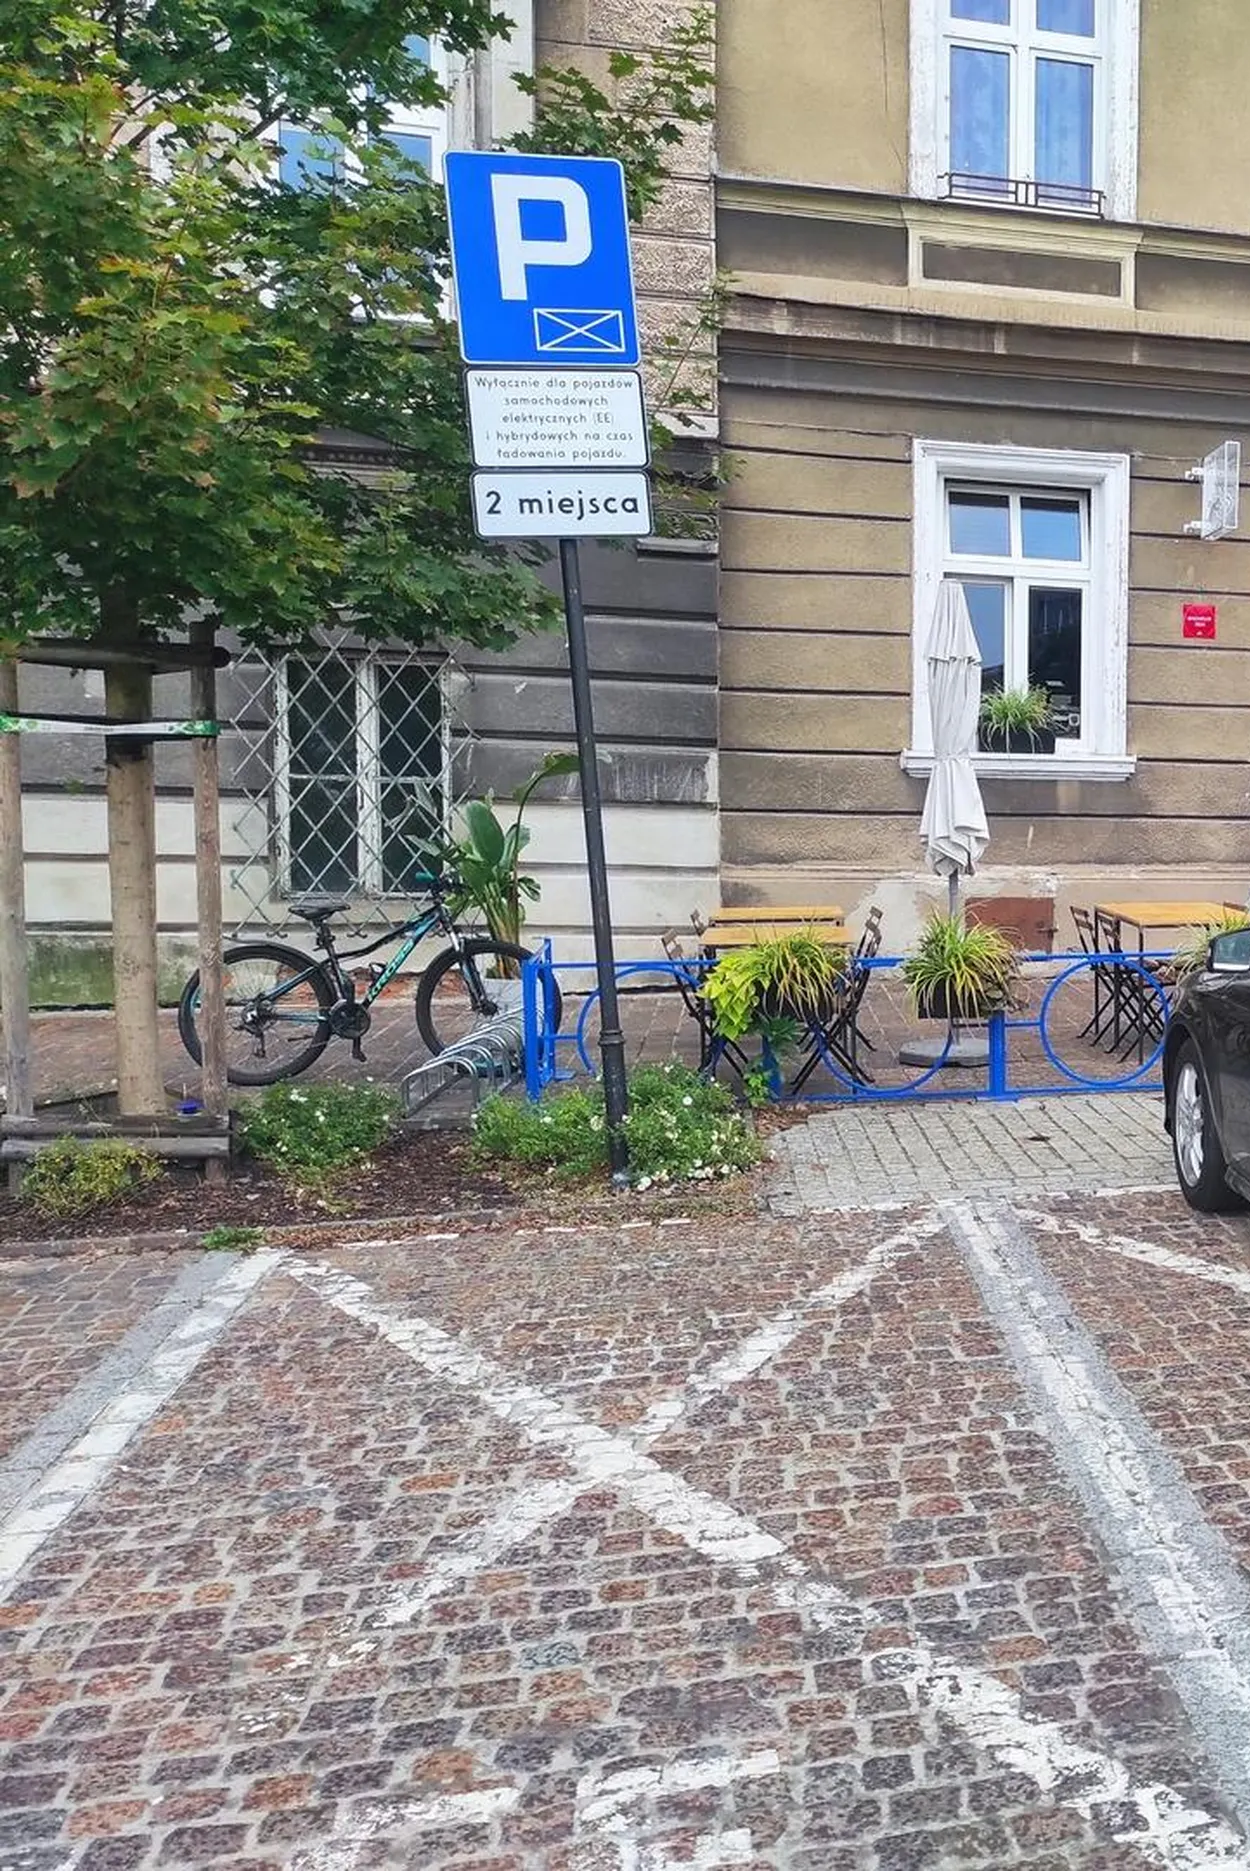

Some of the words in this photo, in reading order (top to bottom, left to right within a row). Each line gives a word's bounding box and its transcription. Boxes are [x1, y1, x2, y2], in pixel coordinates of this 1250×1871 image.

[490, 172, 593, 301] P
[474, 377, 540, 391] Wyłącznie
[546, 377, 566, 388] dla
[573, 378, 633, 391] pojazdów
[504, 394, 609, 408] samochodowych
[502, 412, 587, 425] elektrycznych
[496, 430, 578, 443] hybrydowych
[584, 432, 600, 441] na
[606, 432, 633, 441] czas
[497, 448, 566, 459] ładowania
[486, 490, 502, 514] 2
[518, 489, 640, 521] miejsca
